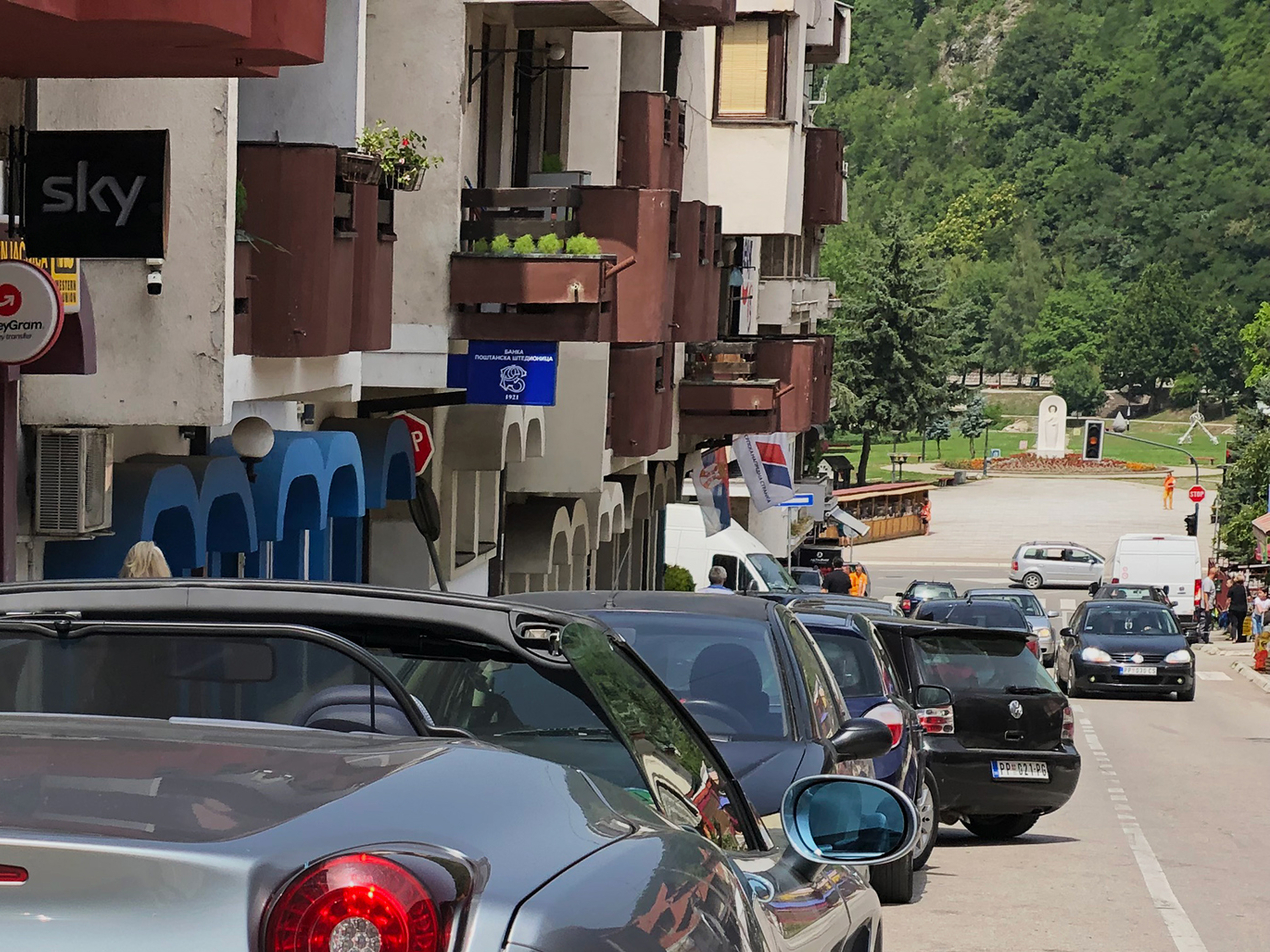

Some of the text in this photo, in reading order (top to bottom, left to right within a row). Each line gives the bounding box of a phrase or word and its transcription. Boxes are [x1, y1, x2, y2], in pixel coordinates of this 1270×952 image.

[42, 160, 146, 226] sky
[512, 355, 554, 363] ШТЕДИОНИЦА
[999, 762, 1011, 775] PP
